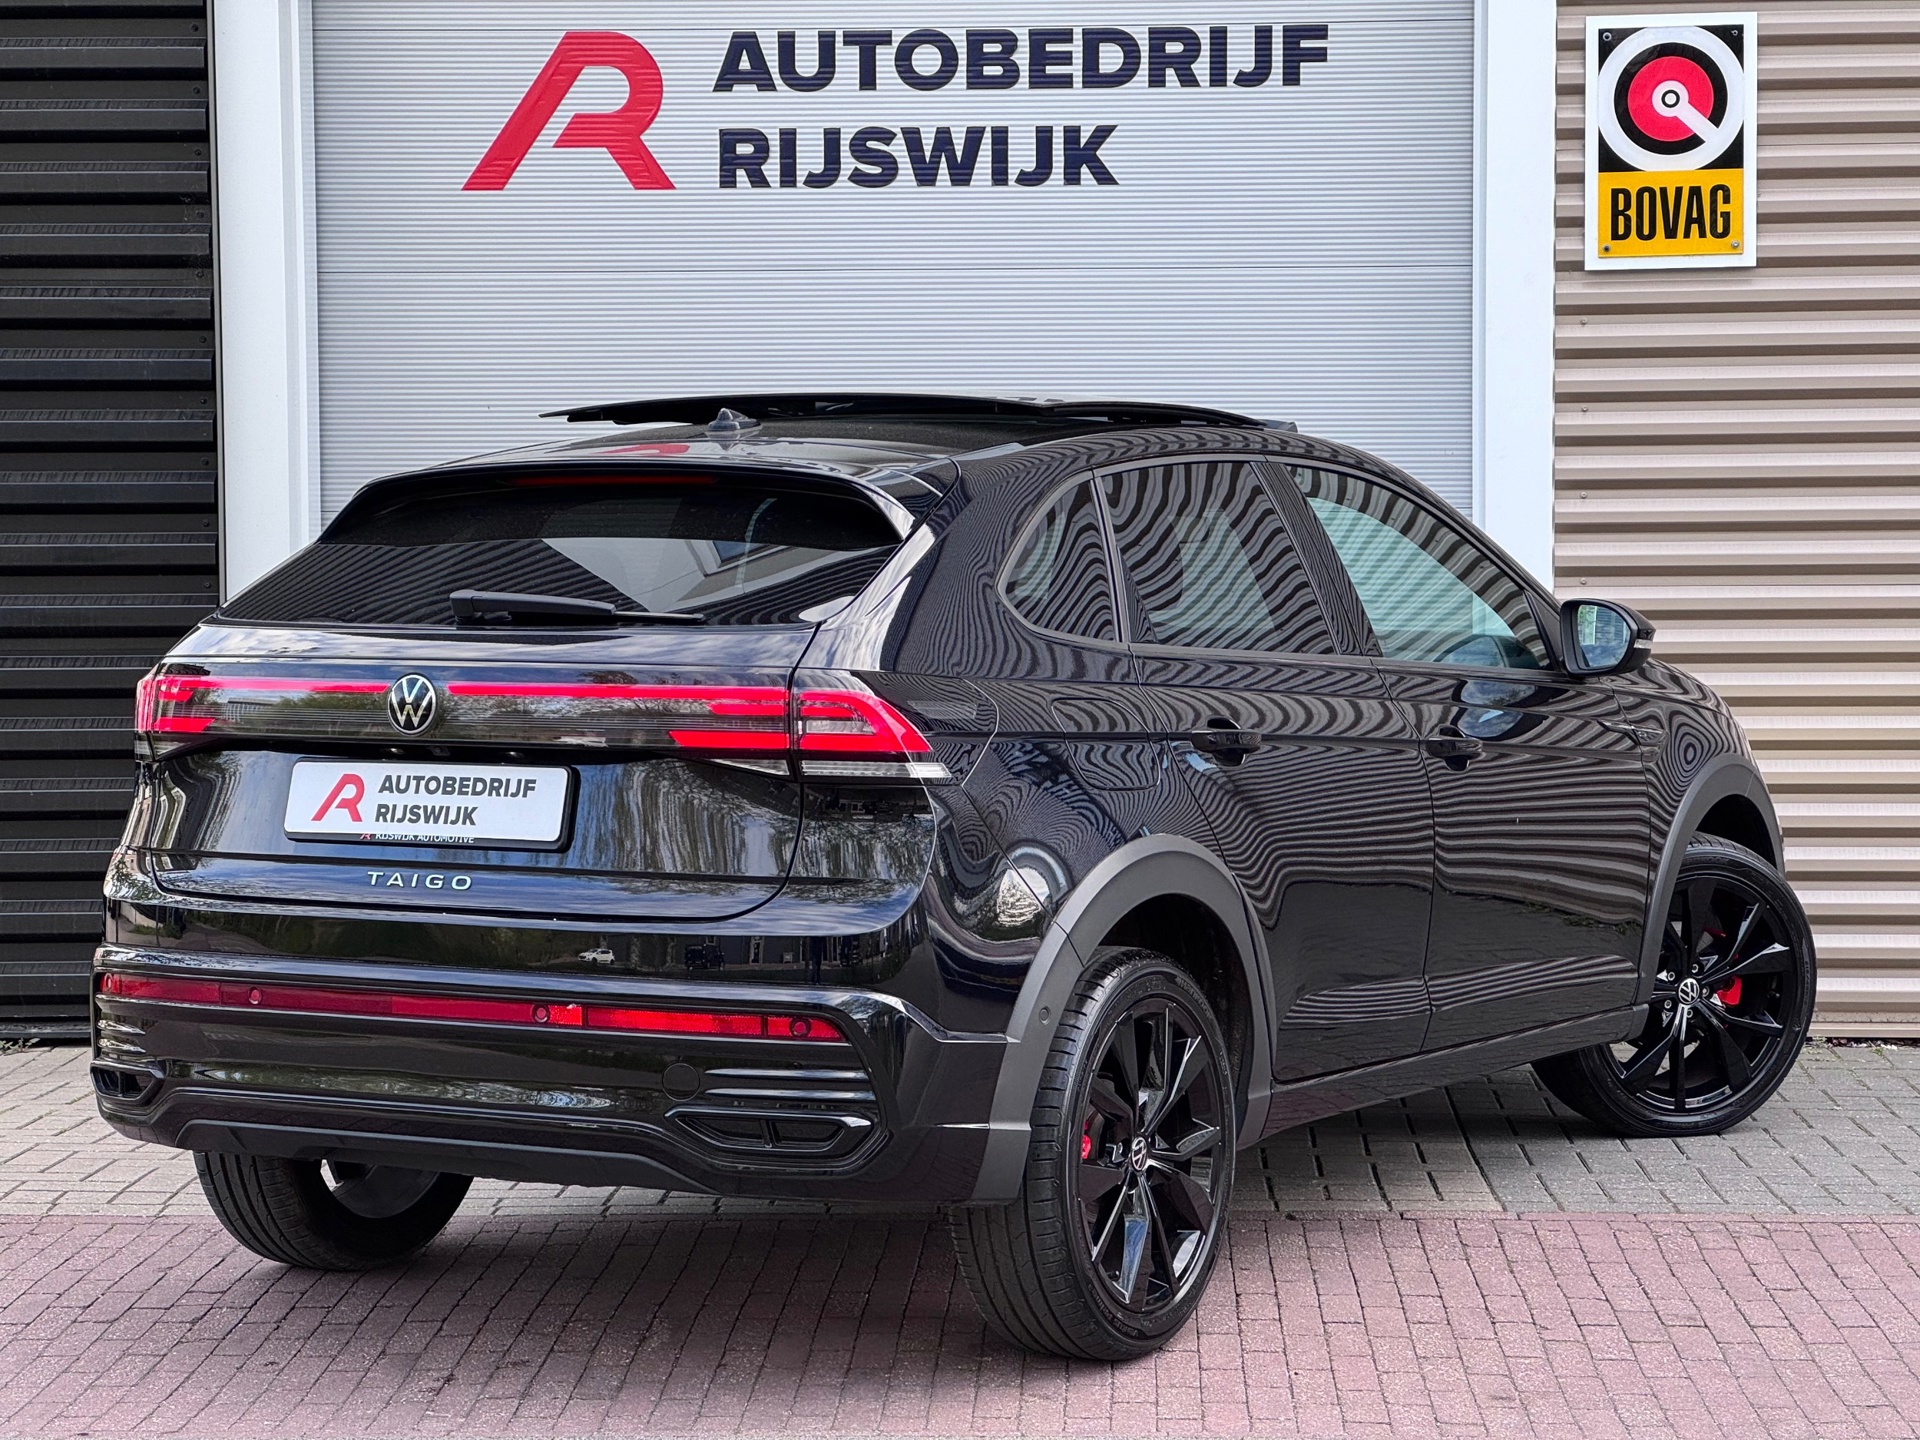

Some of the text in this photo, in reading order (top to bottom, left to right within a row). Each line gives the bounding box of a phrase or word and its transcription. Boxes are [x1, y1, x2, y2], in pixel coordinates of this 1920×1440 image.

[712, 24, 1329, 93] AUTOBEDRIJF
[718, 124, 1119, 188] RIJSWIJK
[1610, 183, 1731, 241] BOVAG
[378, 774, 537, 798] AUTOBEDRIJF
[374, 803, 479, 826] RIJSWIJK
[366, 871, 472, 890] TAIGO
